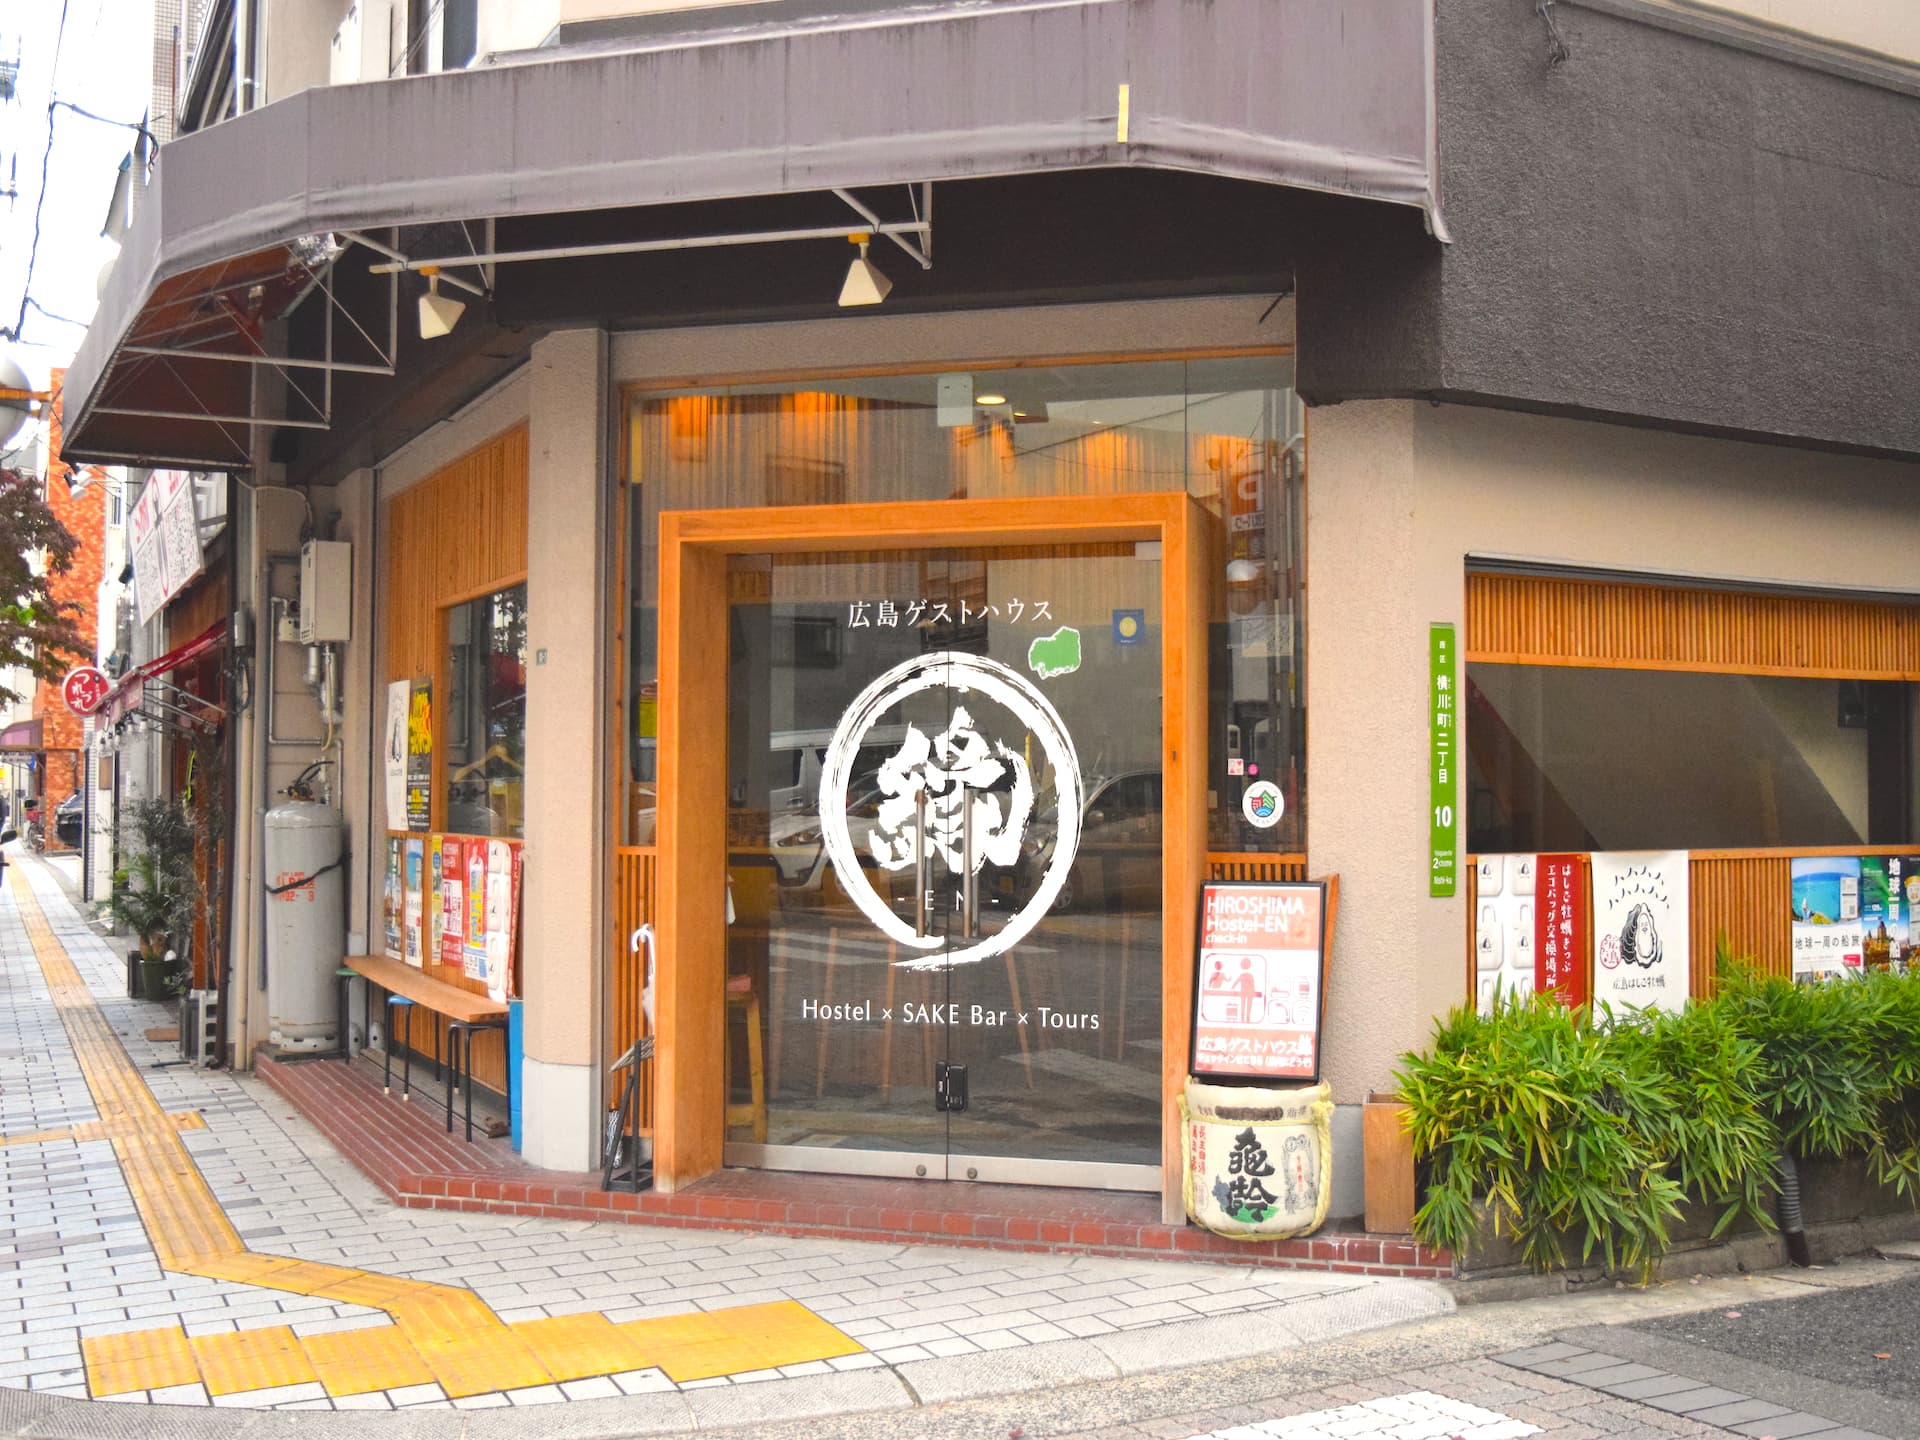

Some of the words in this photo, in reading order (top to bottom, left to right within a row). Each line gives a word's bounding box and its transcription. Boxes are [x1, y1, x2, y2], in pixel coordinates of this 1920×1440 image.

[848, 597, 1053, 629] 広島ゲストハウス
[1437, 675, 1449, 784] 横川町二丁目
[1435, 805, 1452, 828] 10
[1206, 895, 1305, 915] HIROSHIMA
[1206, 914, 1289, 933] Hostel-EN
[1205, 931, 1248, 944] check-in
[1795, 935, 1860, 951] 地球一周の船旅
[802, 999, 871, 1021] Hostel
[903, 1002, 960, 1025] SAKE
[971, 1004, 1007, 1027] Bar
[1038, 1007, 1100, 1030] Tours
